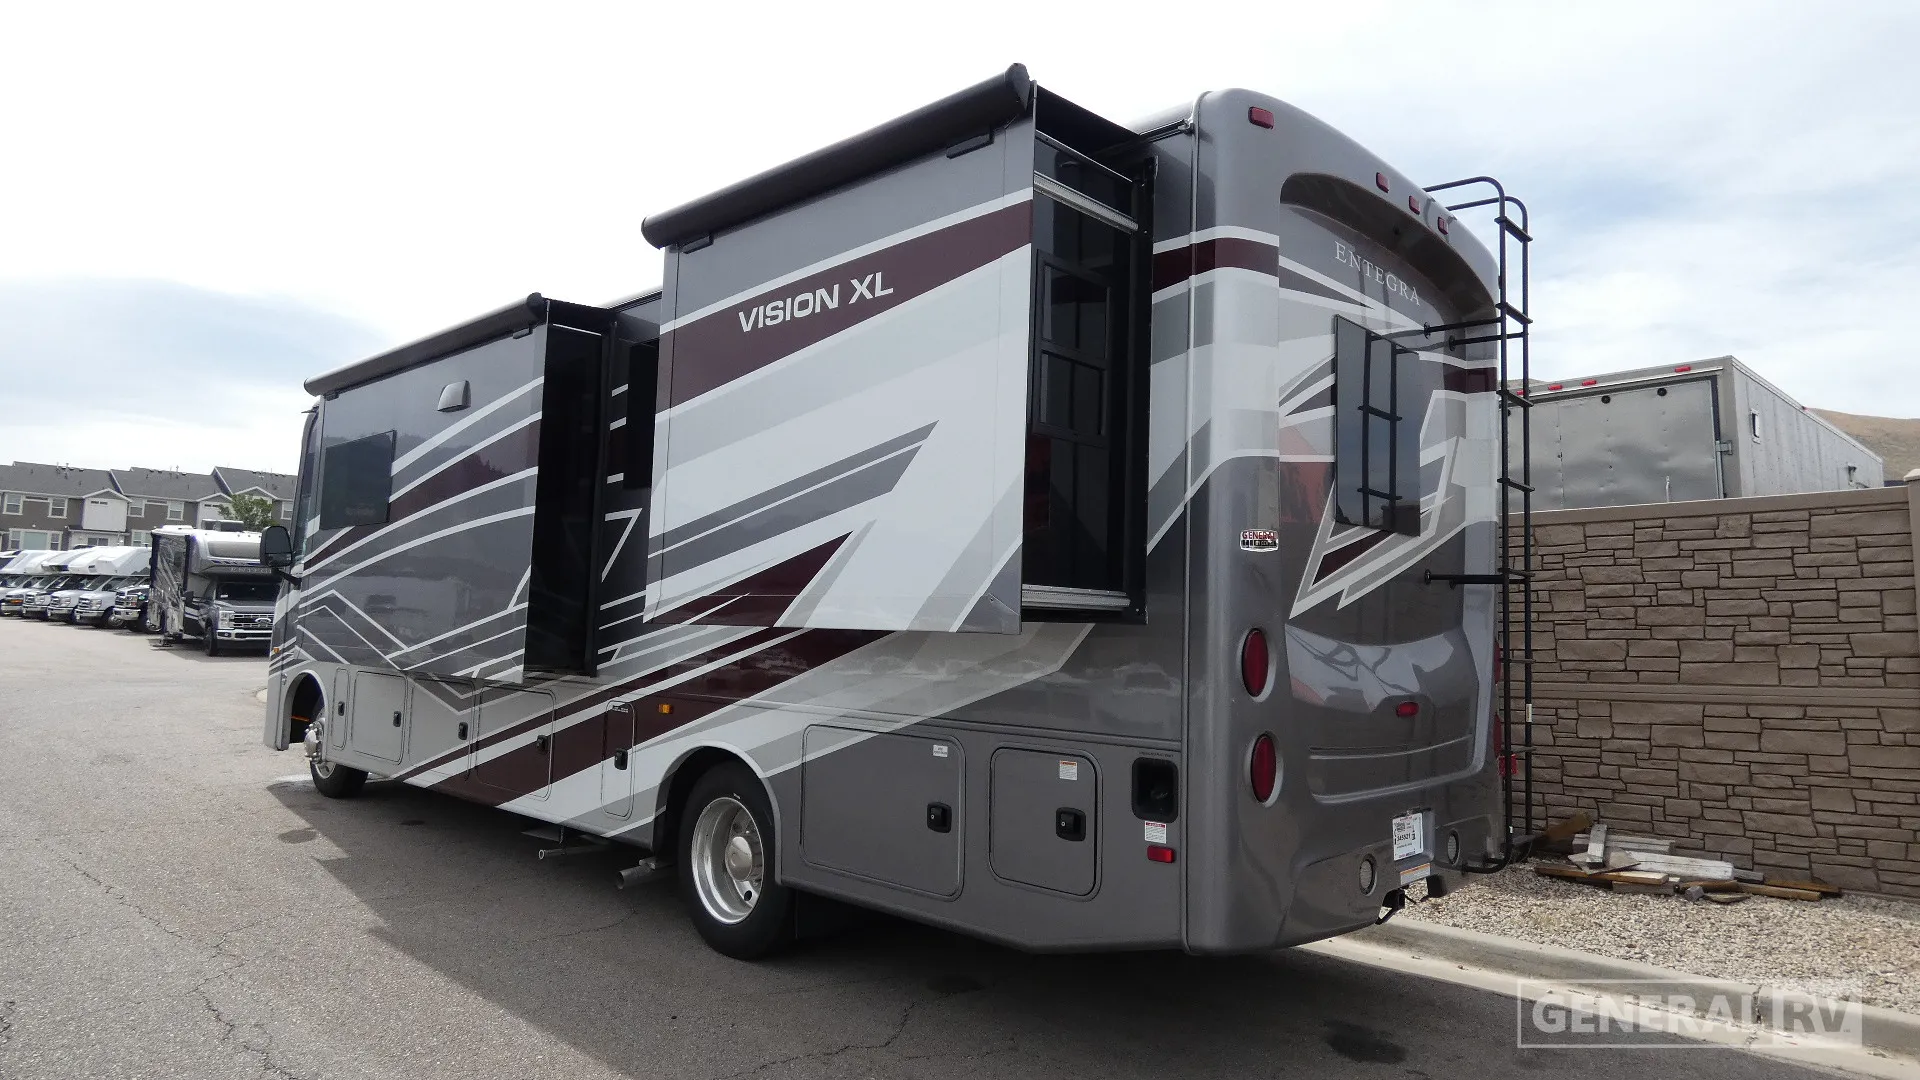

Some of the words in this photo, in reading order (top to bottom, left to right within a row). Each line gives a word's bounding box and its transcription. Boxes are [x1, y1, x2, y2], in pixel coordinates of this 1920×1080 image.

[738, 283, 839, 333] VISION
[848, 271, 894, 305] XL
[1334, 240, 1421, 306] ENTEGRA
